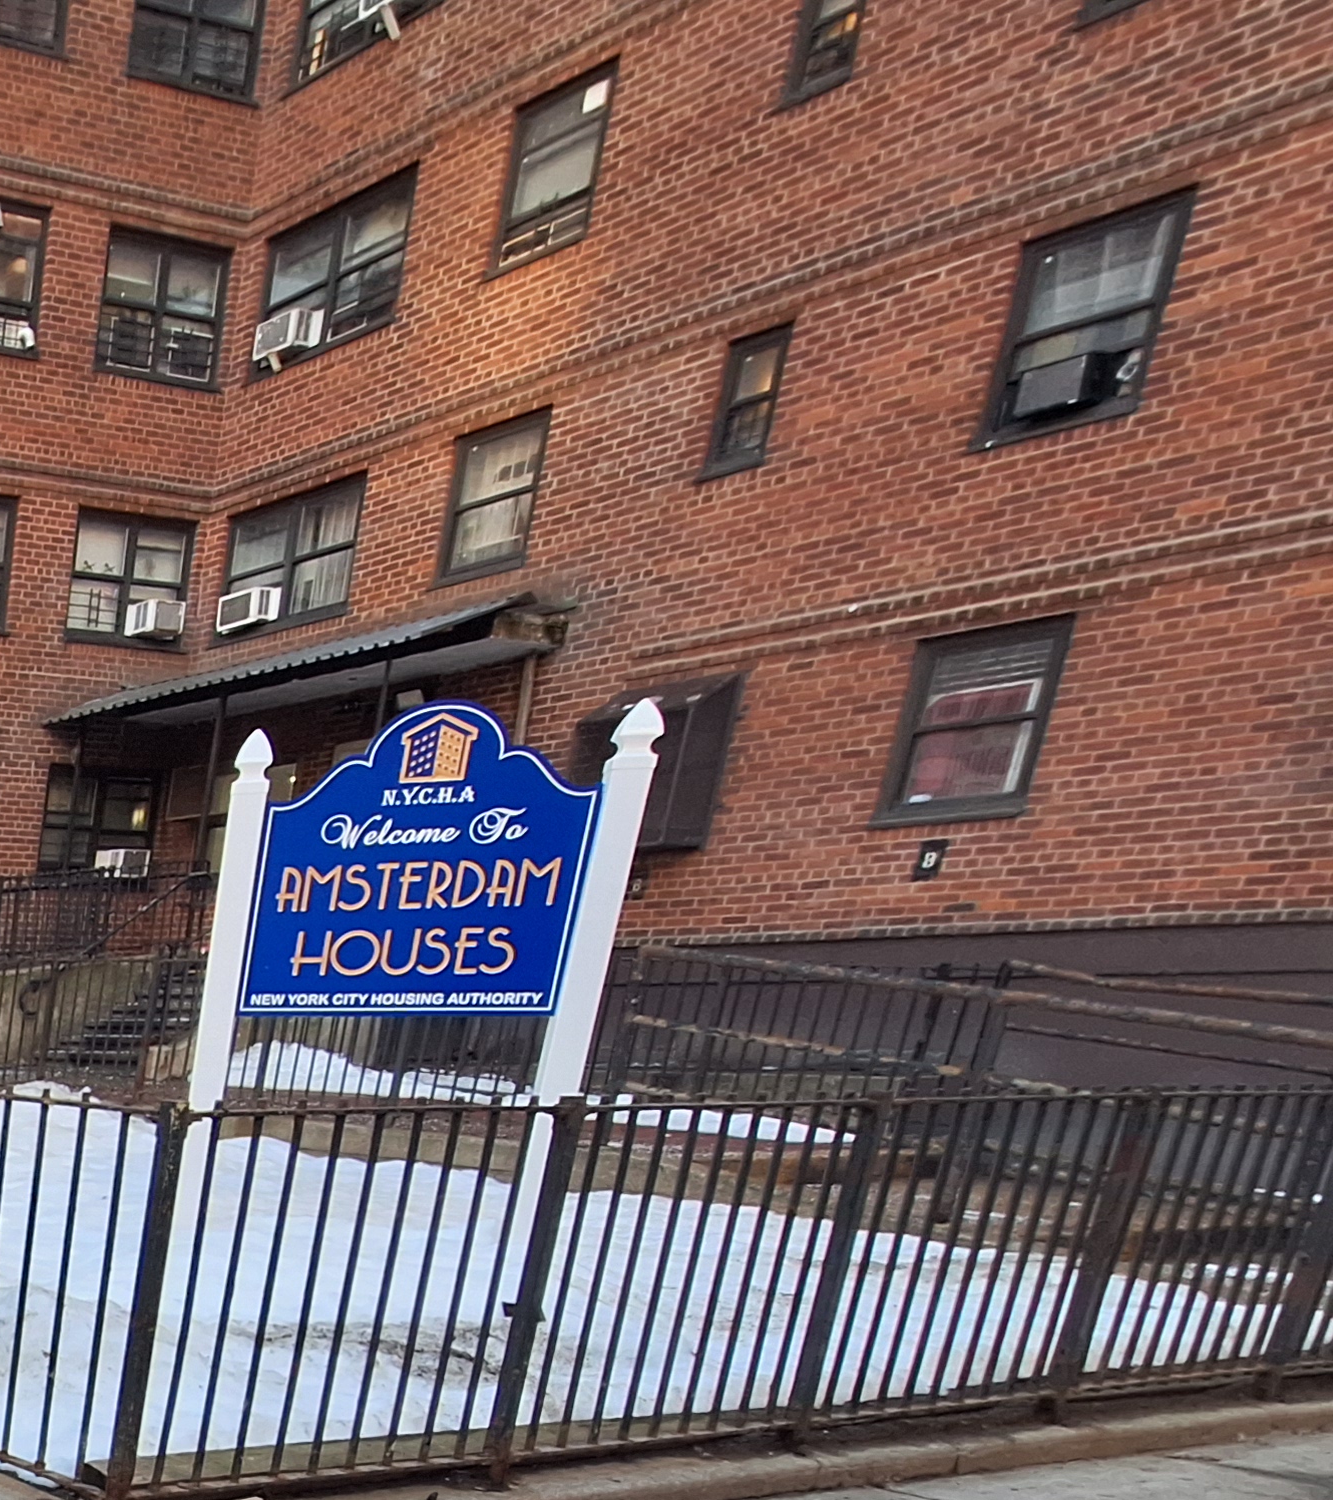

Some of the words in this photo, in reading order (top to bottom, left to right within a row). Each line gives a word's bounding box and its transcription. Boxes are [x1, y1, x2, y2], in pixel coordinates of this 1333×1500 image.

[321, 814, 461, 850] Welcome
[469, 807, 528, 844] To
[276, 857, 563, 912] AMSTERDAM
[290, 927, 516, 976] HOUSES
[250, 994, 286, 1007] NEW
[288, 993, 330, 1006] YORK
[332, 993, 369, 1006] CITY
[370, 992, 445, 1006] HOUSING
[446, 991, 544, 1006] AUTHORITY
